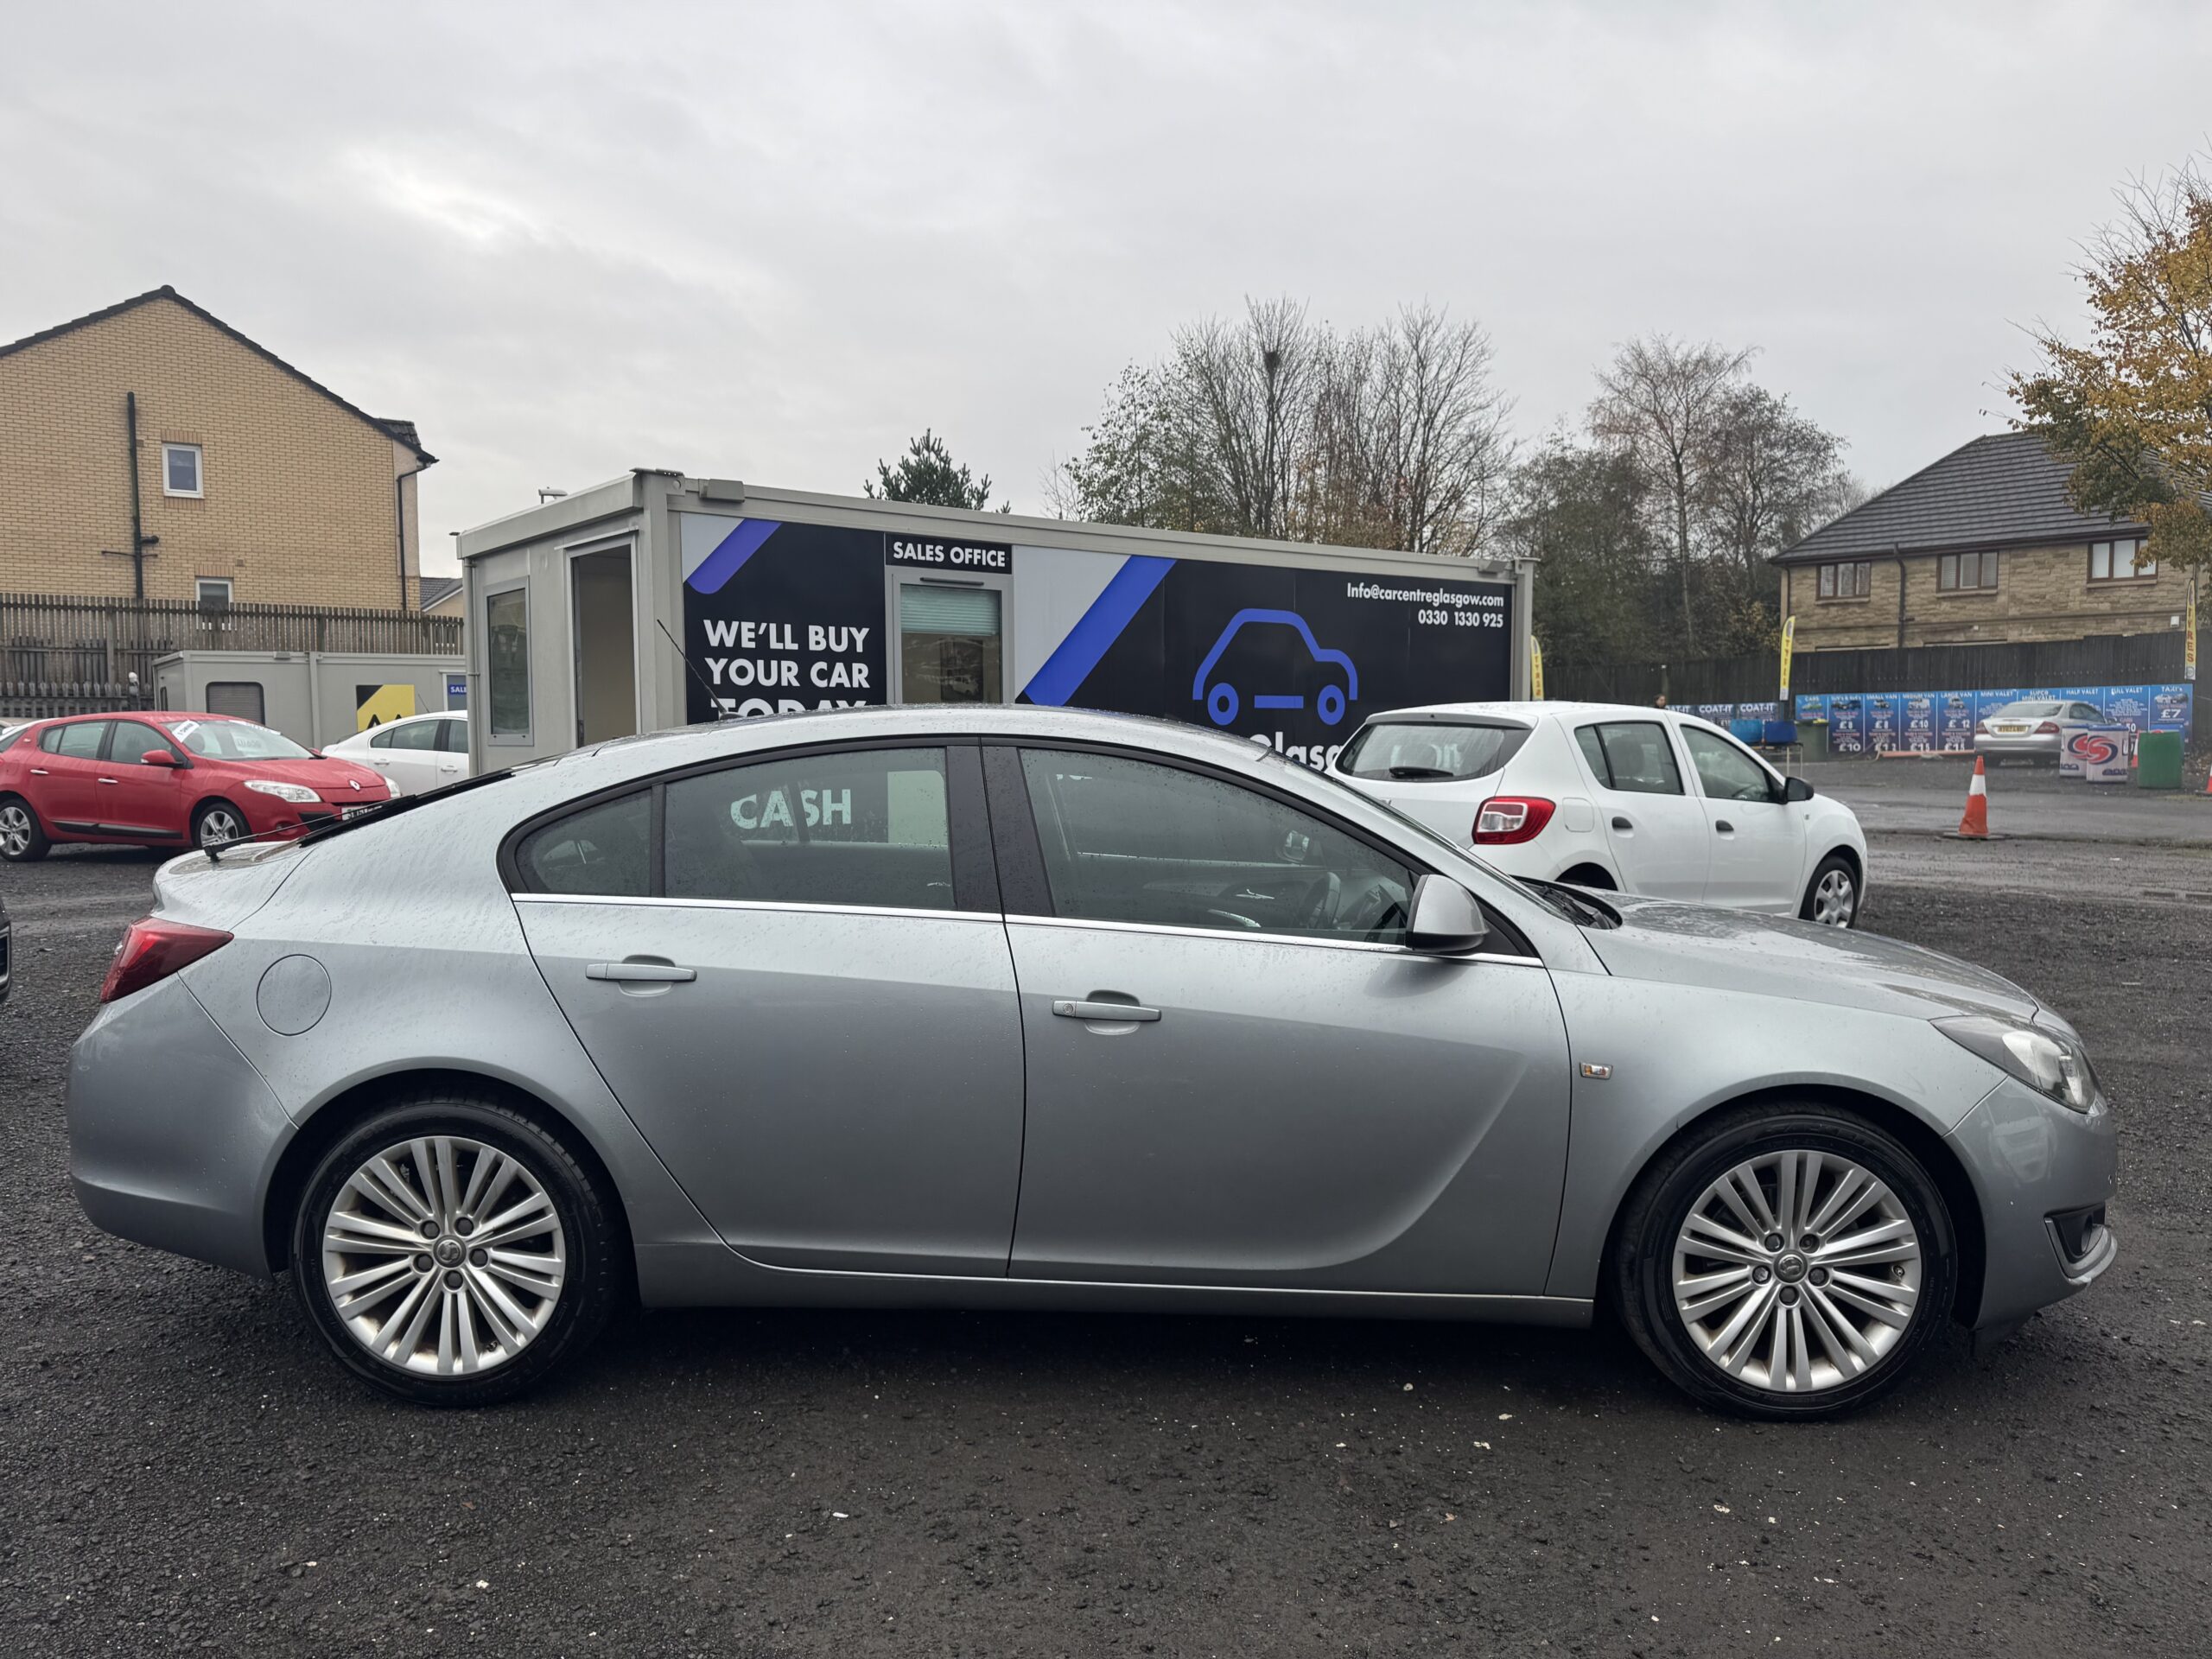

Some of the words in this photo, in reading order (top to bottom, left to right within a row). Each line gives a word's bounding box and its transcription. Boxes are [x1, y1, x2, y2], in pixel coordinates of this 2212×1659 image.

[893, 541, 944, 563] SALES
[950, 546, 1005, 567] OFFICE
[1347, 582, 1504, 607] Info@carcentreglasgow.com
[1418, 609, 1448, 625] 0330
[1453, 612, 1480, 626] 1330
[1482, 613, 1503, 628] 925
[703, 620, 798, 650] WE'LL
[809, 625, 870, 652] BUY
[704, 658, 800, 687] YOUR
[810, 661, 871, 689] CAR
[1699, 703, 1732, 714] COAT-IT
[1740, 702, 1774, 712] COAT-IT
[2161, 709, 2181, 718] £7
[1839, 743, 1861, 752] £10
[730, 788, 852, 830] CASH
